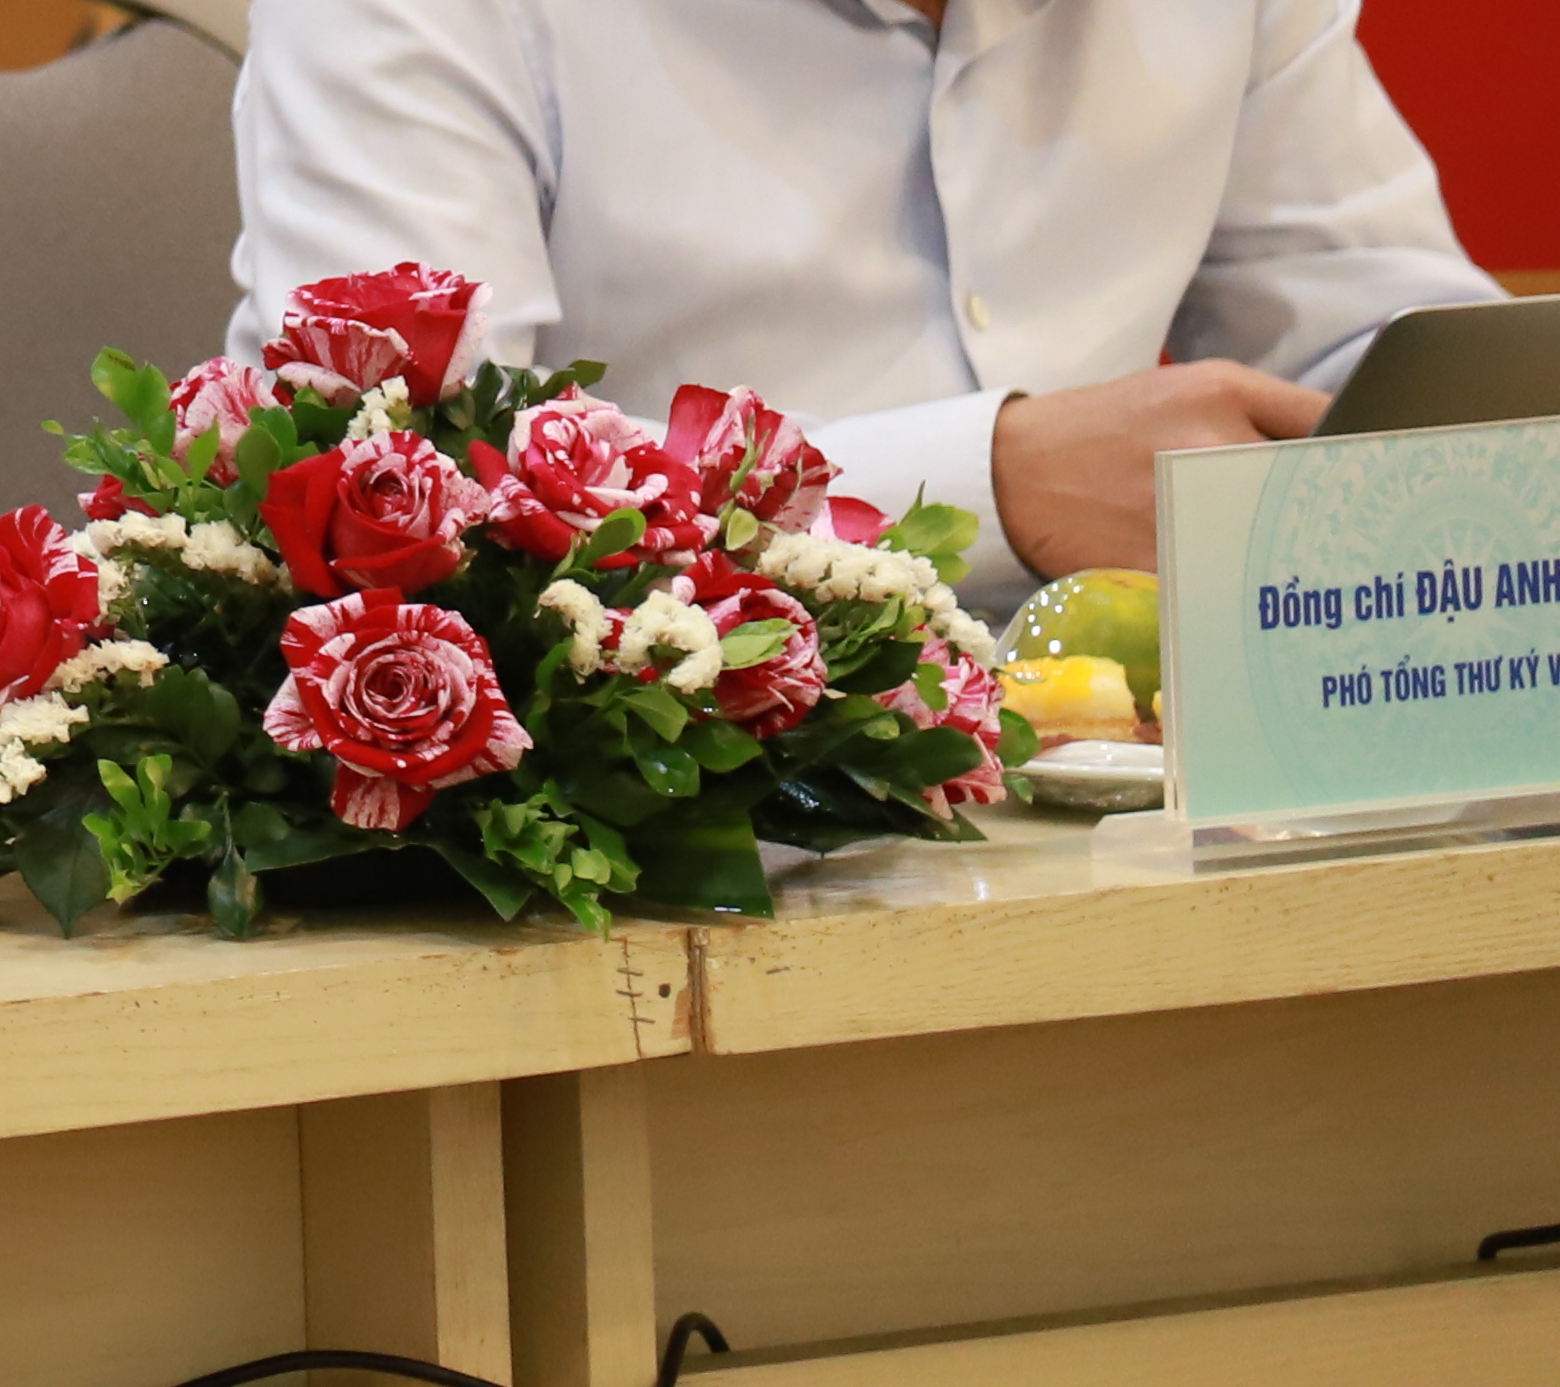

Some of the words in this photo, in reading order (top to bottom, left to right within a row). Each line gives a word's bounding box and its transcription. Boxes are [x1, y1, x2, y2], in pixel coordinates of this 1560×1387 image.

[1259, 575, 1342, 630] Đồng
[1354, 571, 1404, 621] chí
[1416, 558, 1483, 623] ĐẬU
[1495, 558, 1560, 608] ANH
[1322, 664, 1372, 708] PHÓ
[1380, 654, 1446, 702] TỔNG
[1454, 654, 1503, 695] THƯ
[1509, 647, 1539, 690] KÝ
